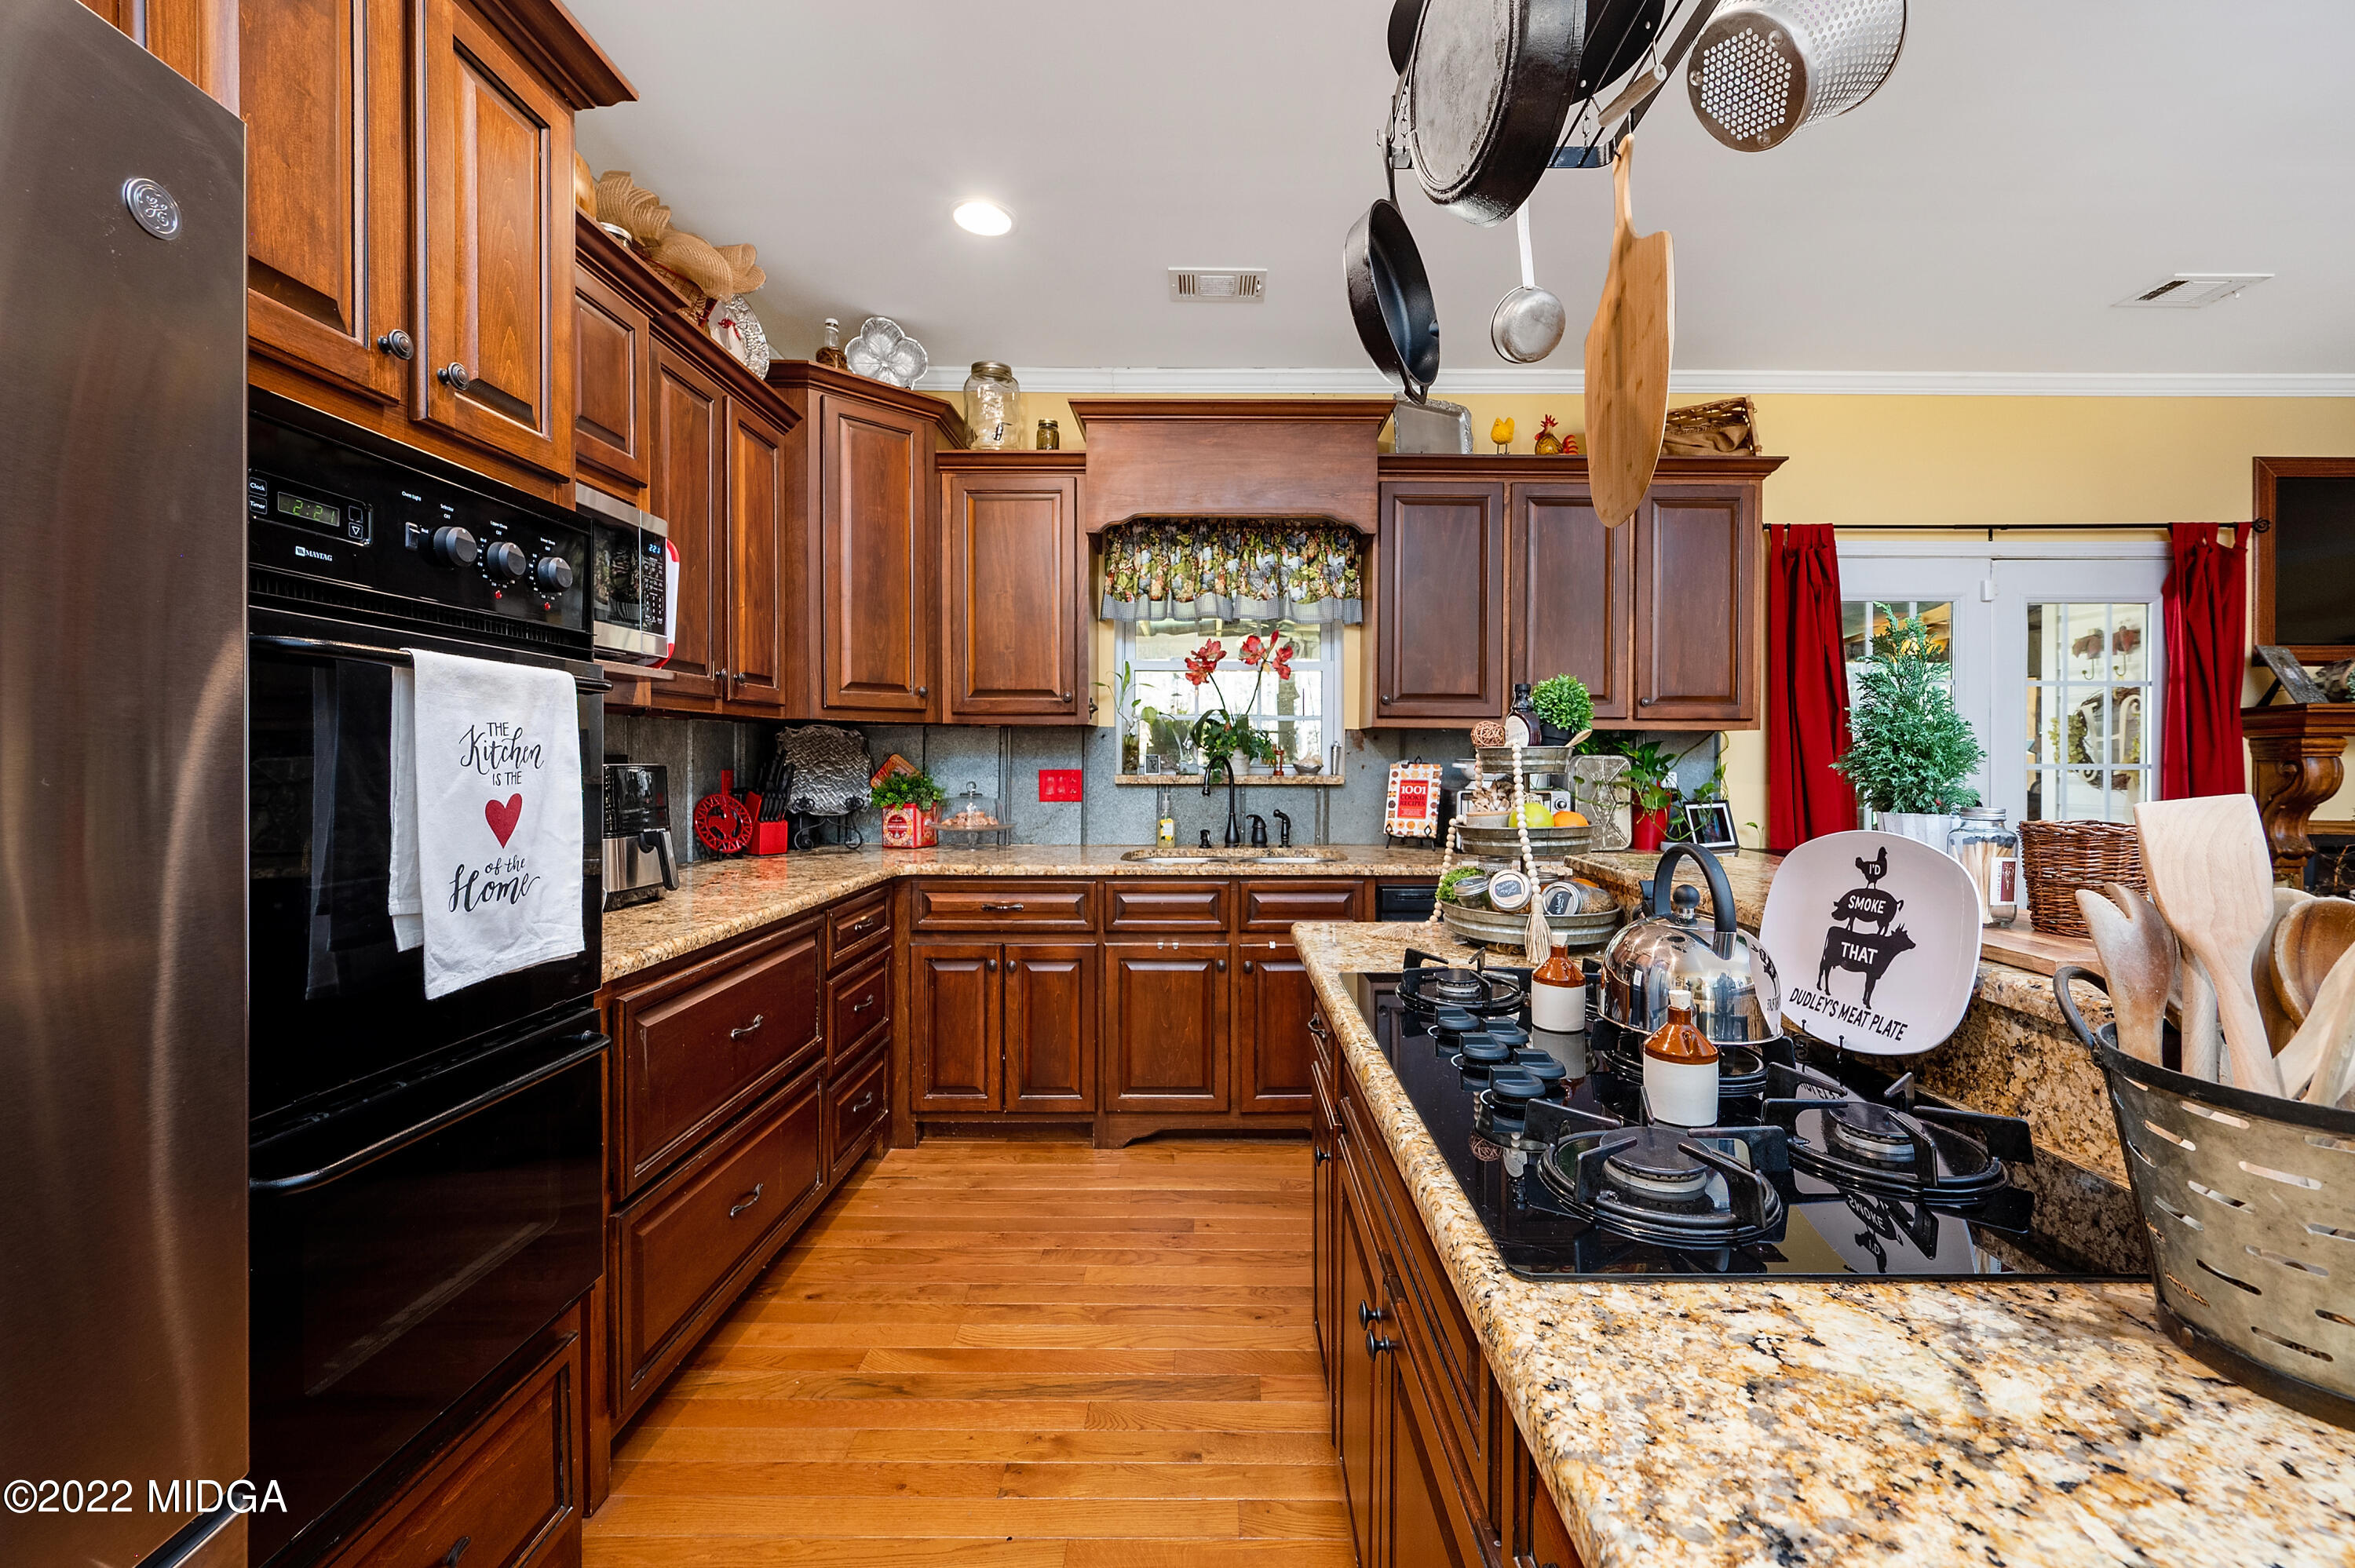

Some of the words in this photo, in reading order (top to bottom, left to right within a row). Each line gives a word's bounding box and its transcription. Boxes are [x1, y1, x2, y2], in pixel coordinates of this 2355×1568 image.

[249, 482, 265, 491] Clock
[249, 500, 266, 509] Timer
[293, 499, 335, 523] 2:21
[305, 549, 333, 562] MAYTAG
[487, 722, 509, 737] THE
[458, 724, 544, 775] Kitchen
[492, 773, 502, 786] IS
[505, 771, 522, 786] THE
[1400, 785, 1426, 795] 1001
[484, 857, 502, 876] of
[506, 855, 525, 873] the
[1868, 863, 1881, 876] I'D
[448, 863, 541, 913] Home
[1848, 895, 1886, 914] SMOKE
[1841, 941, 1879, 965] THAT
[1789, 987, 1839, 1017] DUDLEY'S
[1838, 1004, 1871, 1028] MEAT
[1868, 1014, 1908, 1041] PLATE
